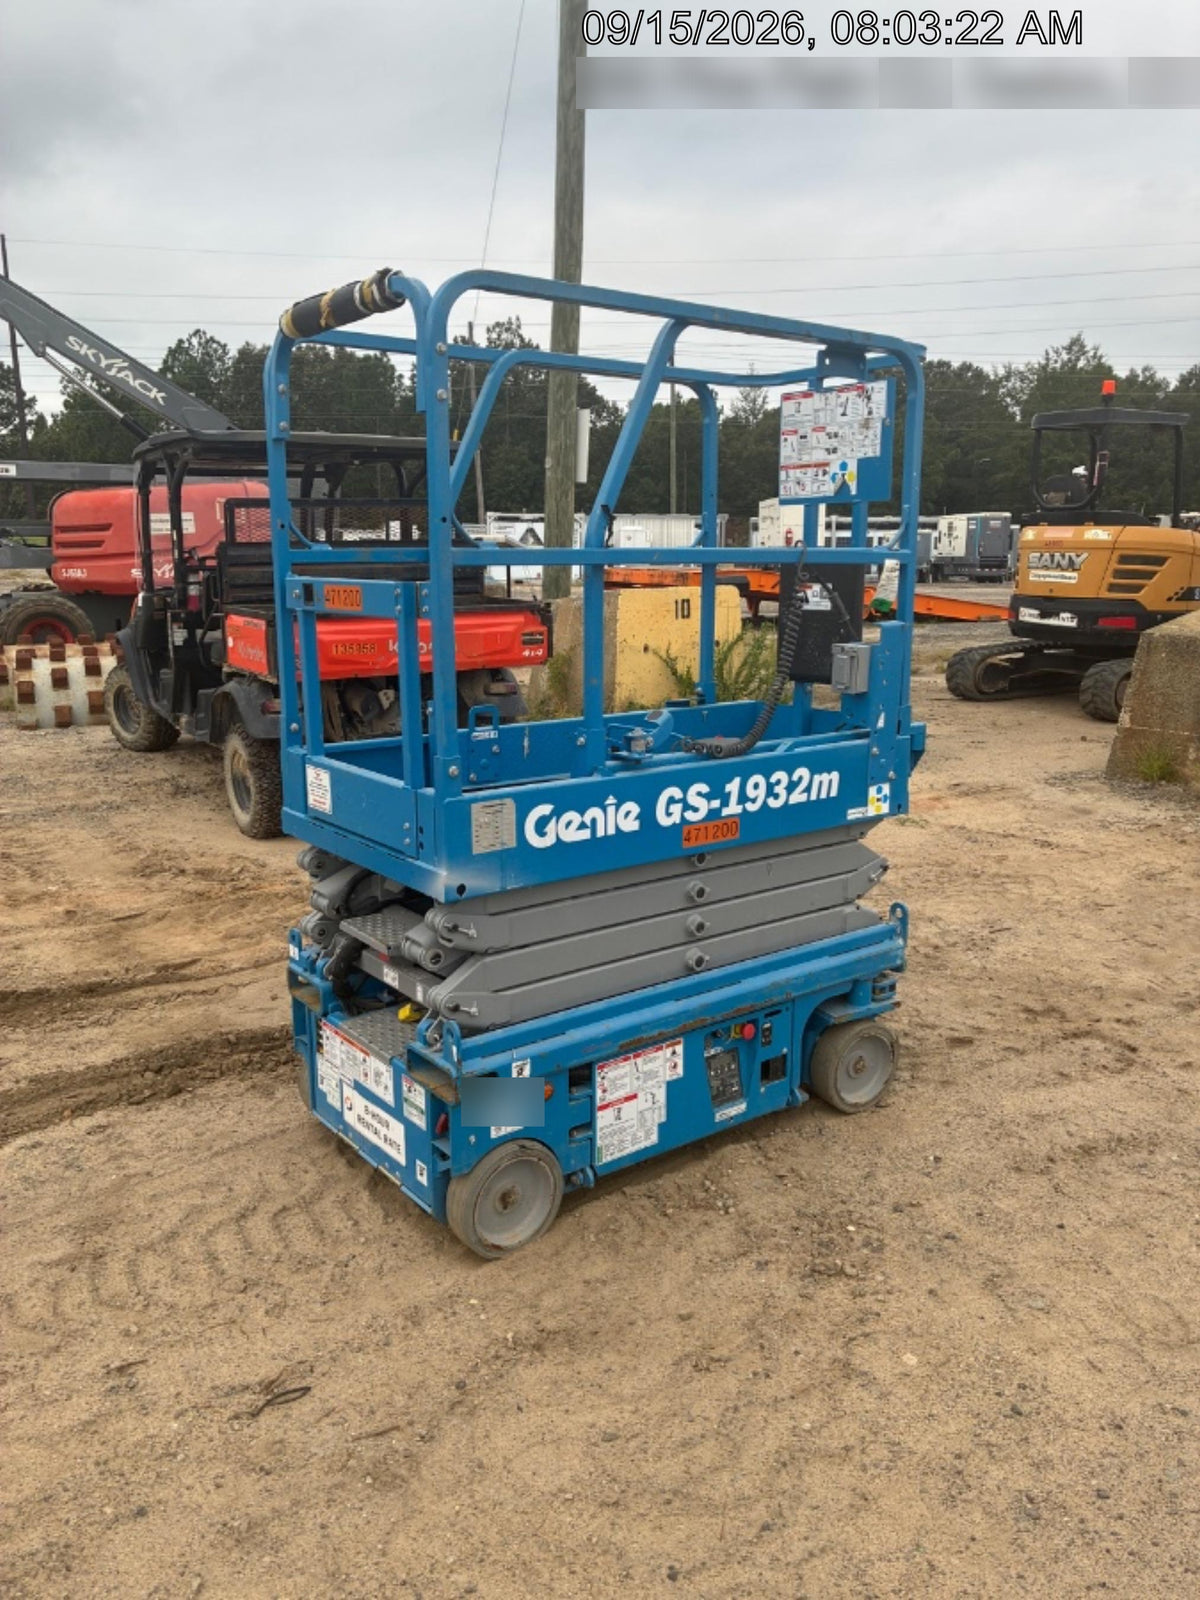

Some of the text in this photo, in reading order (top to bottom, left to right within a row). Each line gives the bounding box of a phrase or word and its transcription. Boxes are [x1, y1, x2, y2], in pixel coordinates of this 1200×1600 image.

[65, 335, 168, 406] SKYJACK
[1027, 552, 1089, 570] SANY
[325, 588, 362, 607] 471200
[674, 598, 691, 620] 10
[655, 766, 841, 827] GS-1932m
[683, 821, 739, 844] 471200
